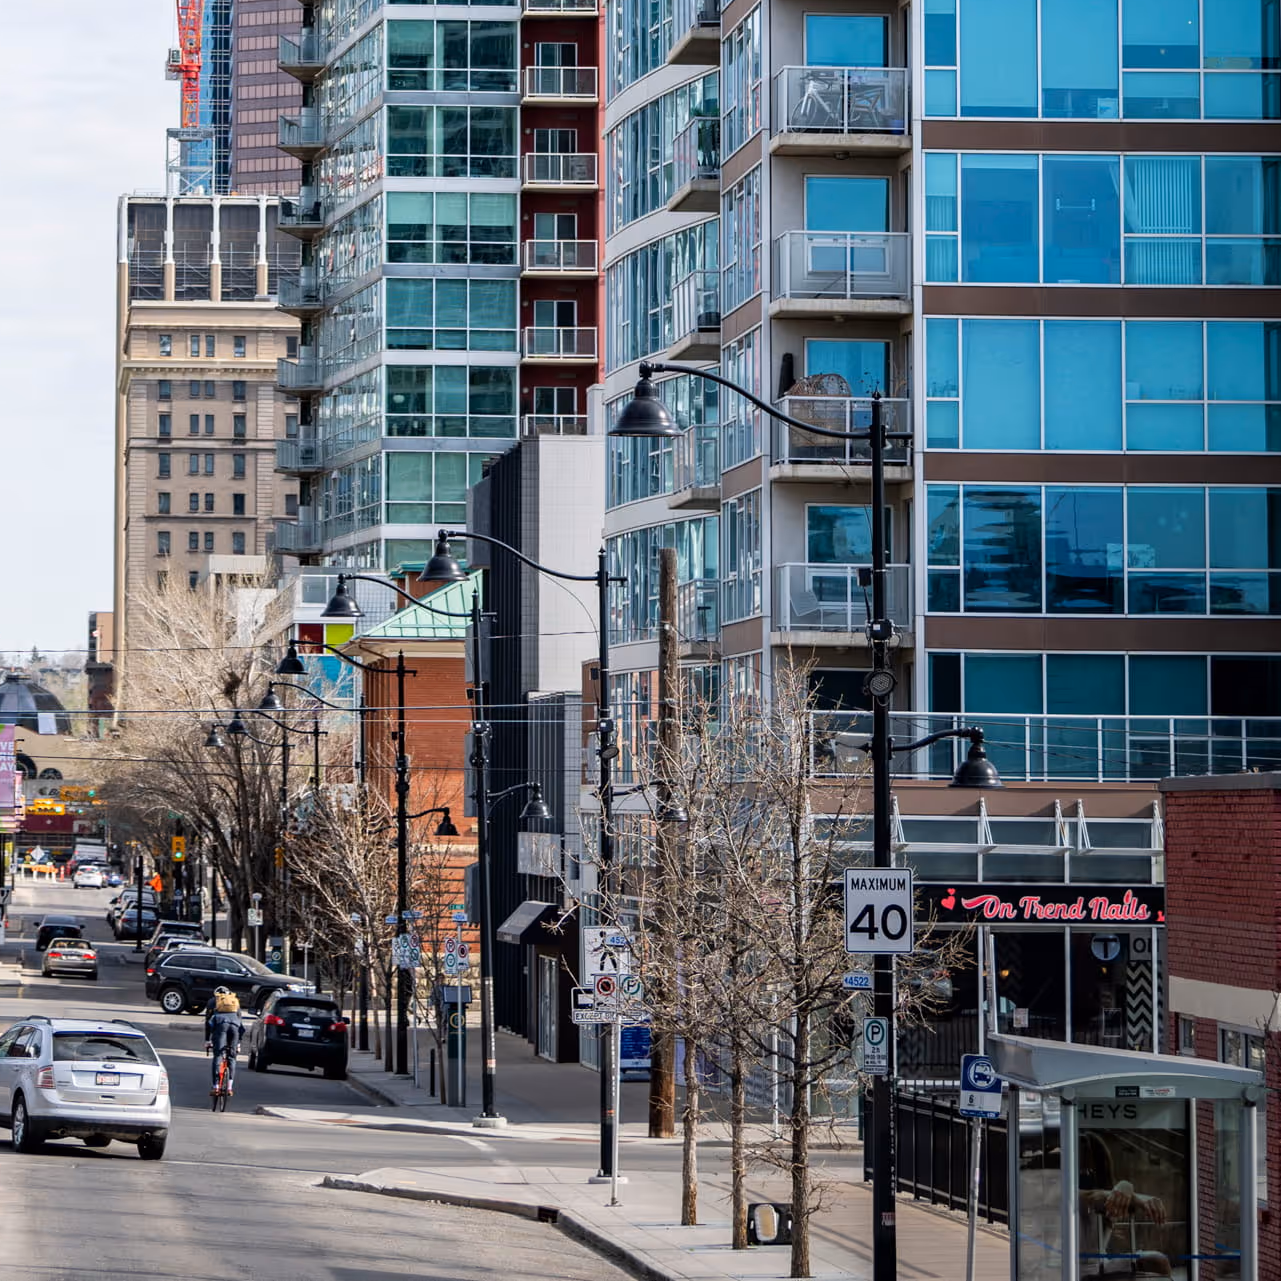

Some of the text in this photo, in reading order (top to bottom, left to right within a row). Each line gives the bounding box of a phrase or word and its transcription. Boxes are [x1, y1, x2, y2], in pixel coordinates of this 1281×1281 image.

[851, 877, 906, 891] MAXIMUM
[961, 889, 1151, 920] On Trend Nails
[849, 903, 908, 941] 40
[610, 936, 629, 944] 452
[848, 975, 869, 987] 4522
